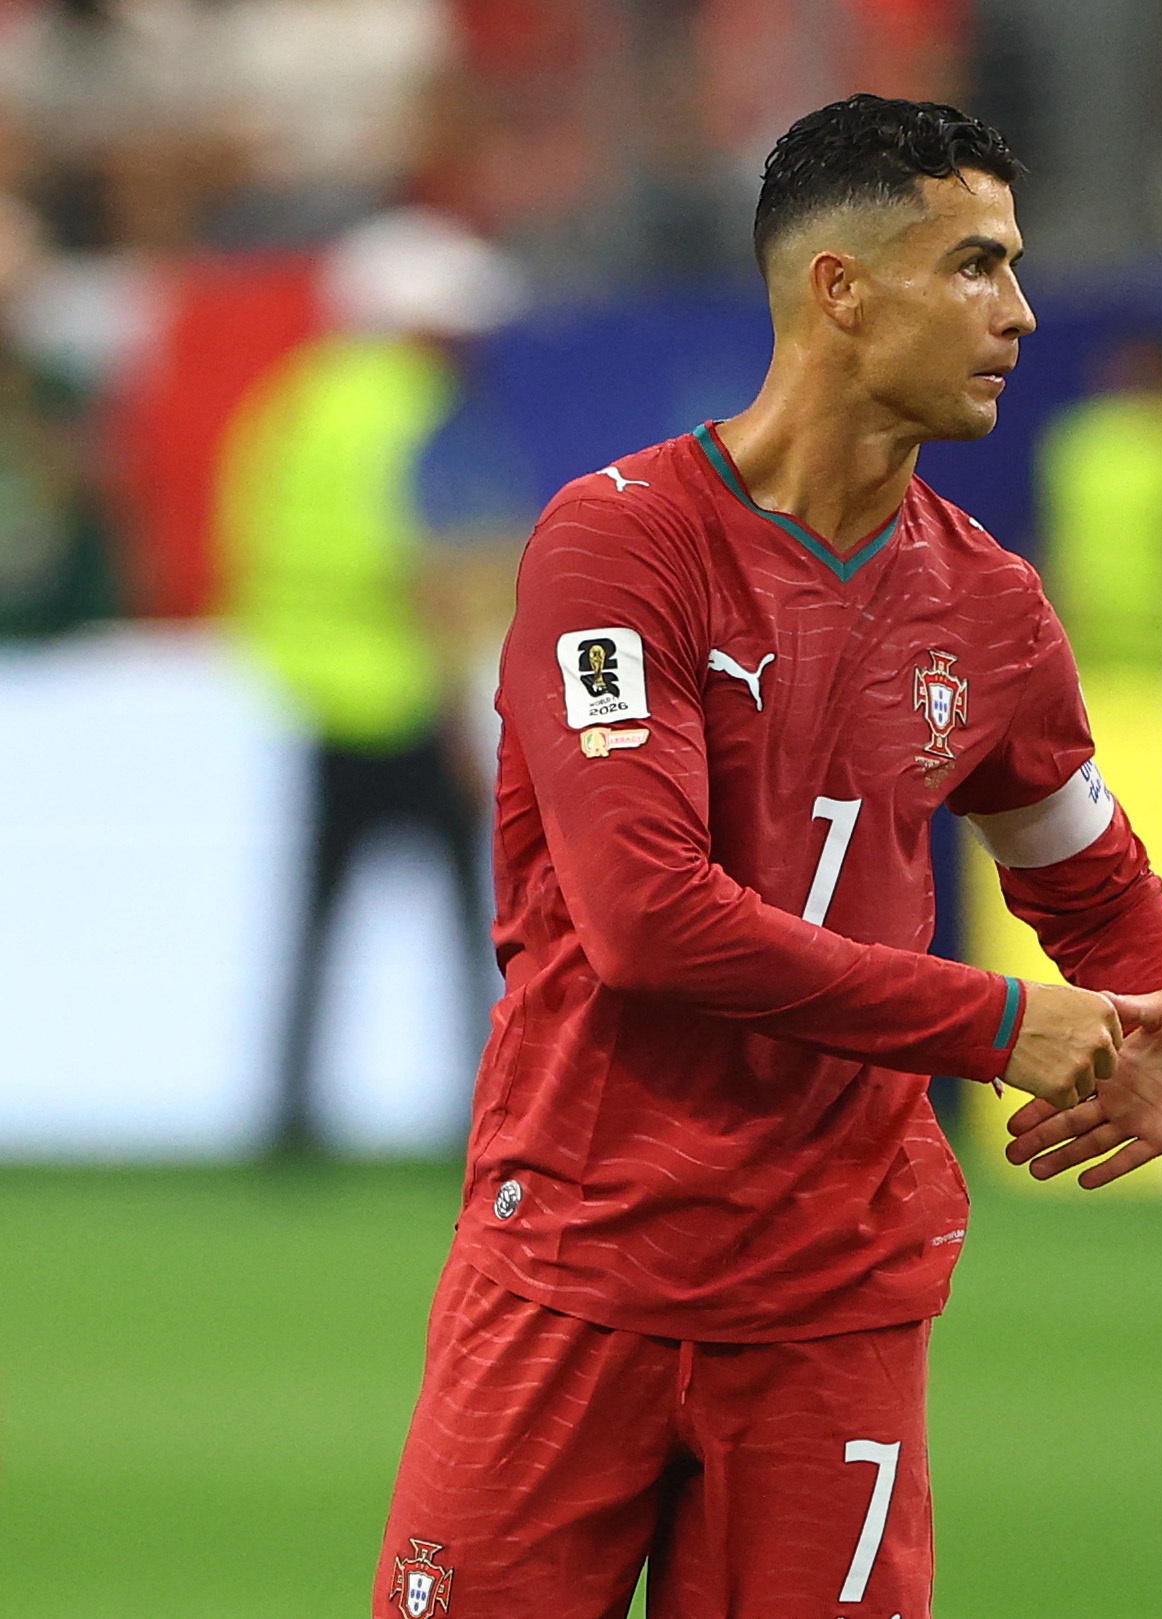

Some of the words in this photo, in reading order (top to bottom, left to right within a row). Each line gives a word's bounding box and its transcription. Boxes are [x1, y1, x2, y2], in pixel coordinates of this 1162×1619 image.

[588, 701, 629, 716] 2026
[801, 795, 863, 928] 7
[838, 1439, 902, 1602] 7
